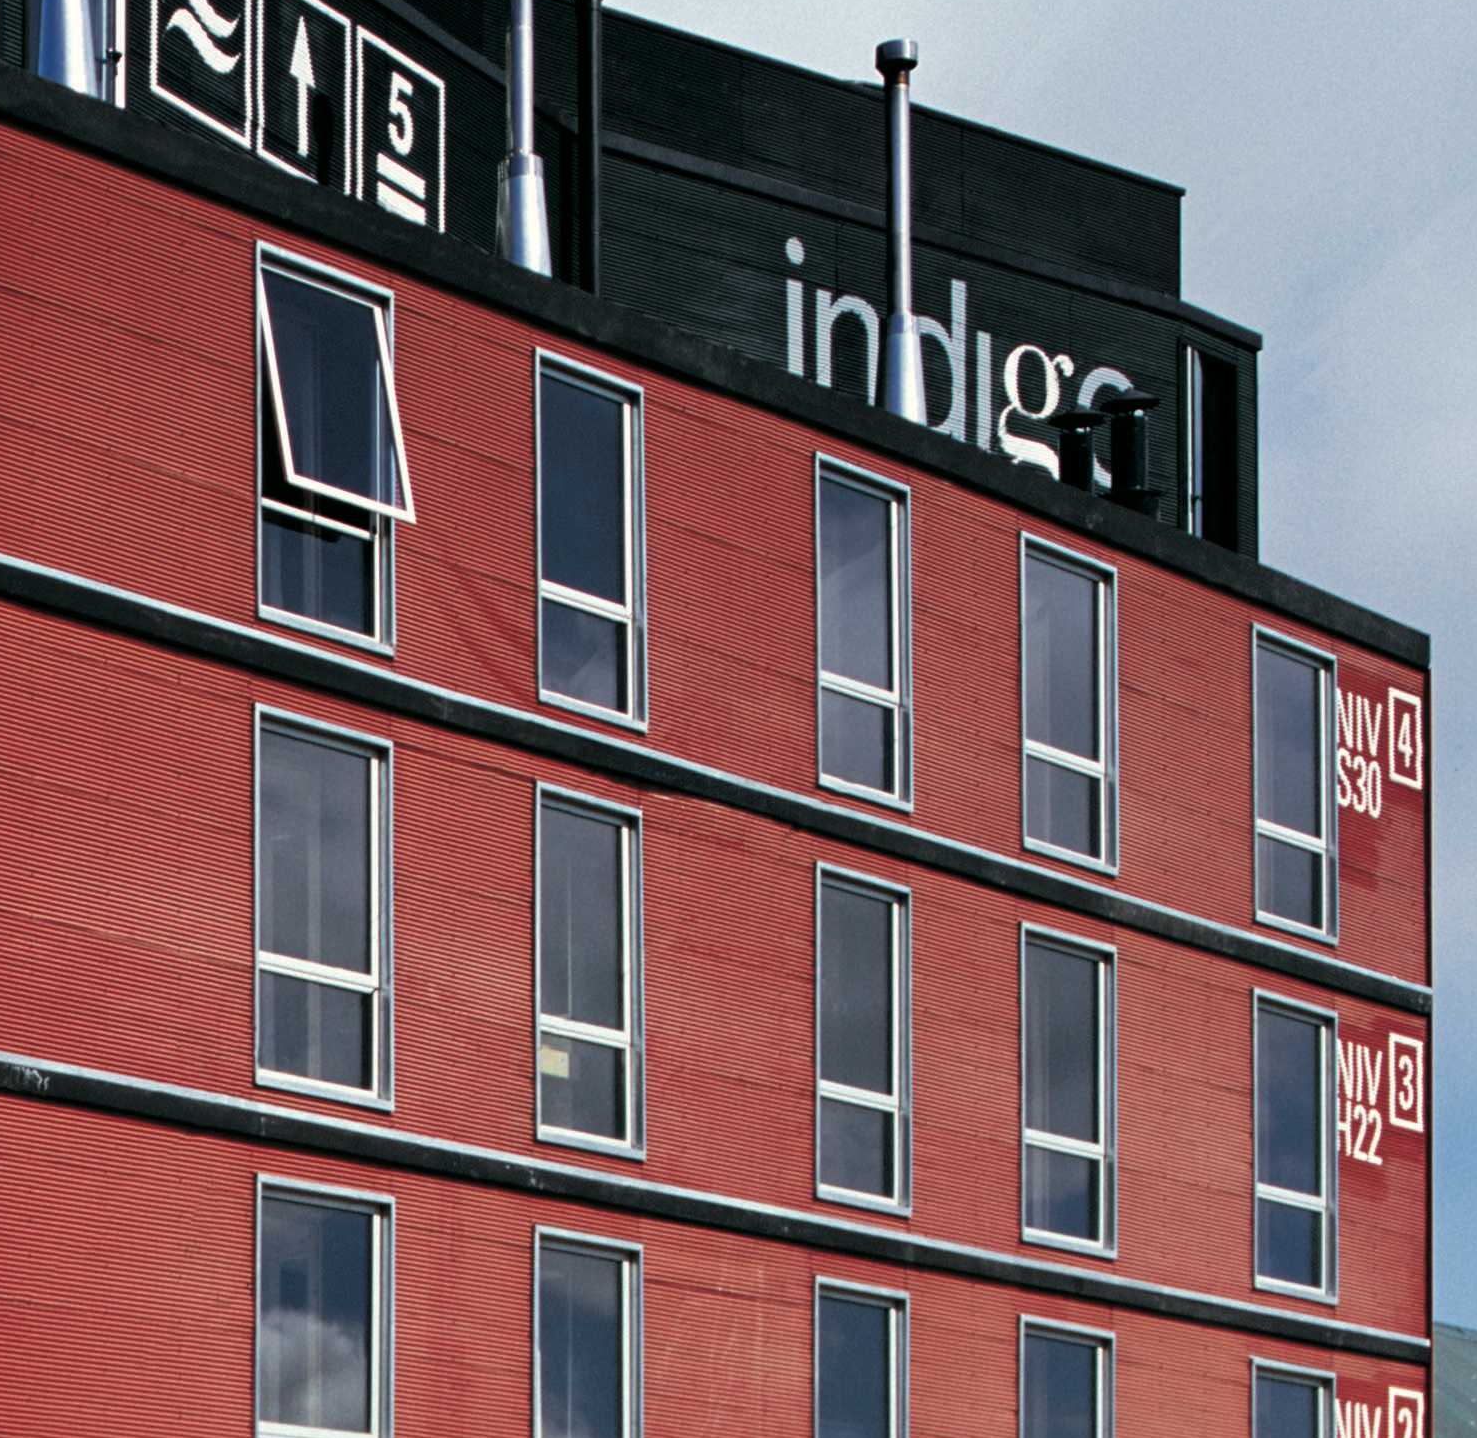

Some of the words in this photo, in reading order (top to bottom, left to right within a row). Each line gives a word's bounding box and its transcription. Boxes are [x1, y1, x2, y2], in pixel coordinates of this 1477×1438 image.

[388, 72, 414, 155] 5
[1336, 688, 1382, 757] NIV
[1398, 713, 1413, 768] 4
[1336, 747, 1382, 819] S30
[1337, 1038, 1383, 1106] NIV
[1398, 1055, 1414, 1111] 3
[1336, 1097, 1383, 1165] H22
